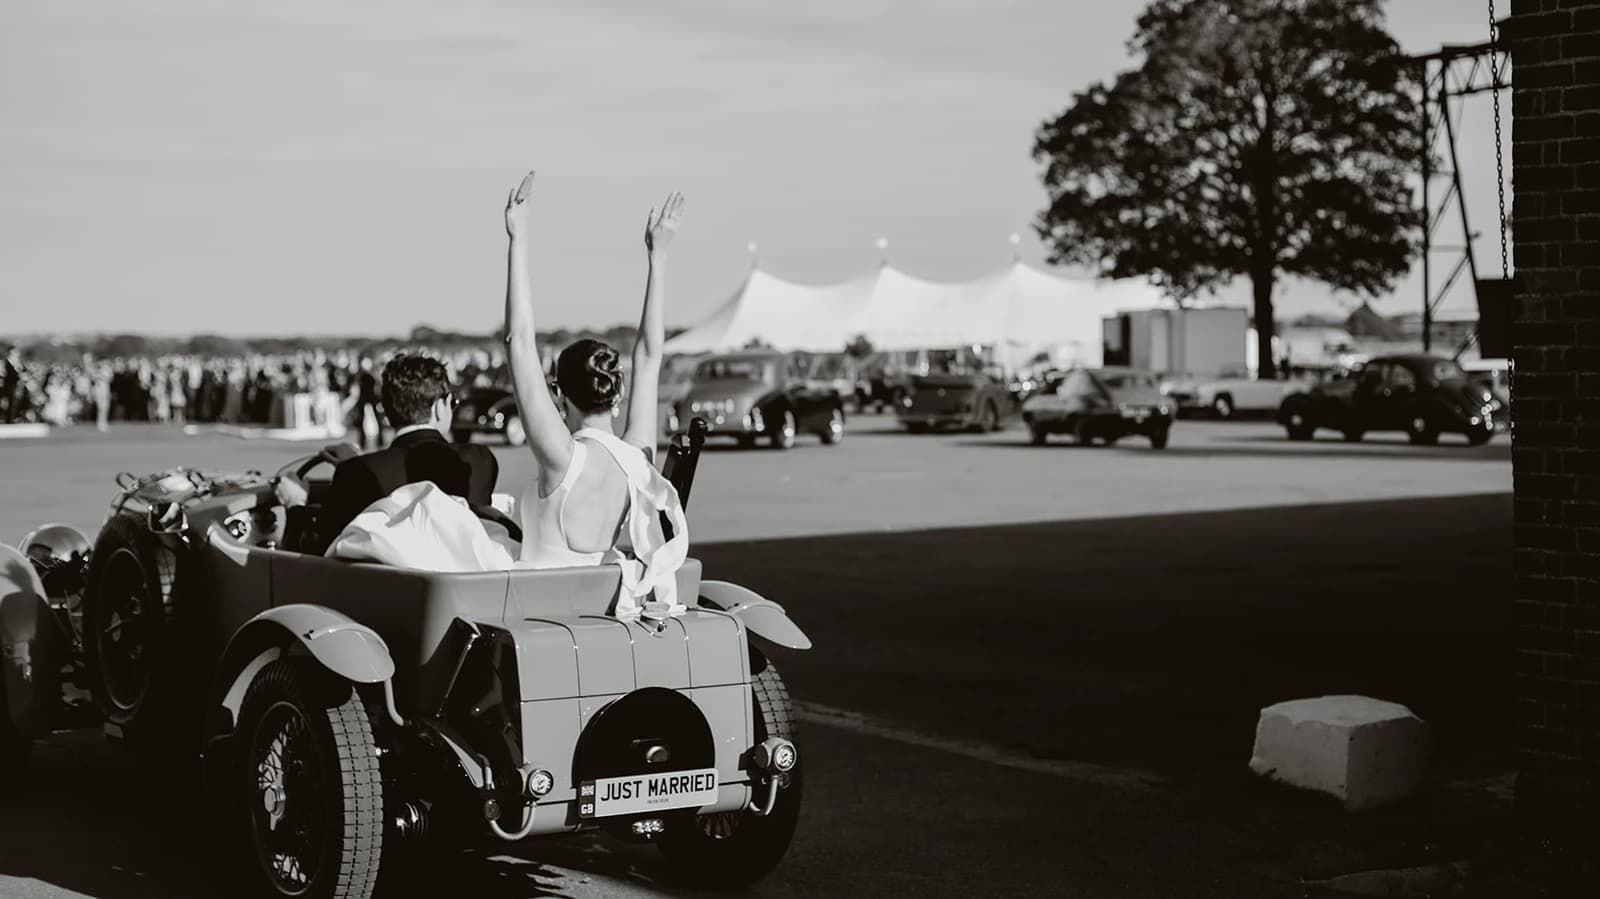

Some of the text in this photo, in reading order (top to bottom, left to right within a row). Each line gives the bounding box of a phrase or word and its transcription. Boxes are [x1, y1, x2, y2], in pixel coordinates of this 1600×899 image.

[600, 773, 715, 802] JUST MARRIED
[581, 803, 594, 814] GB
